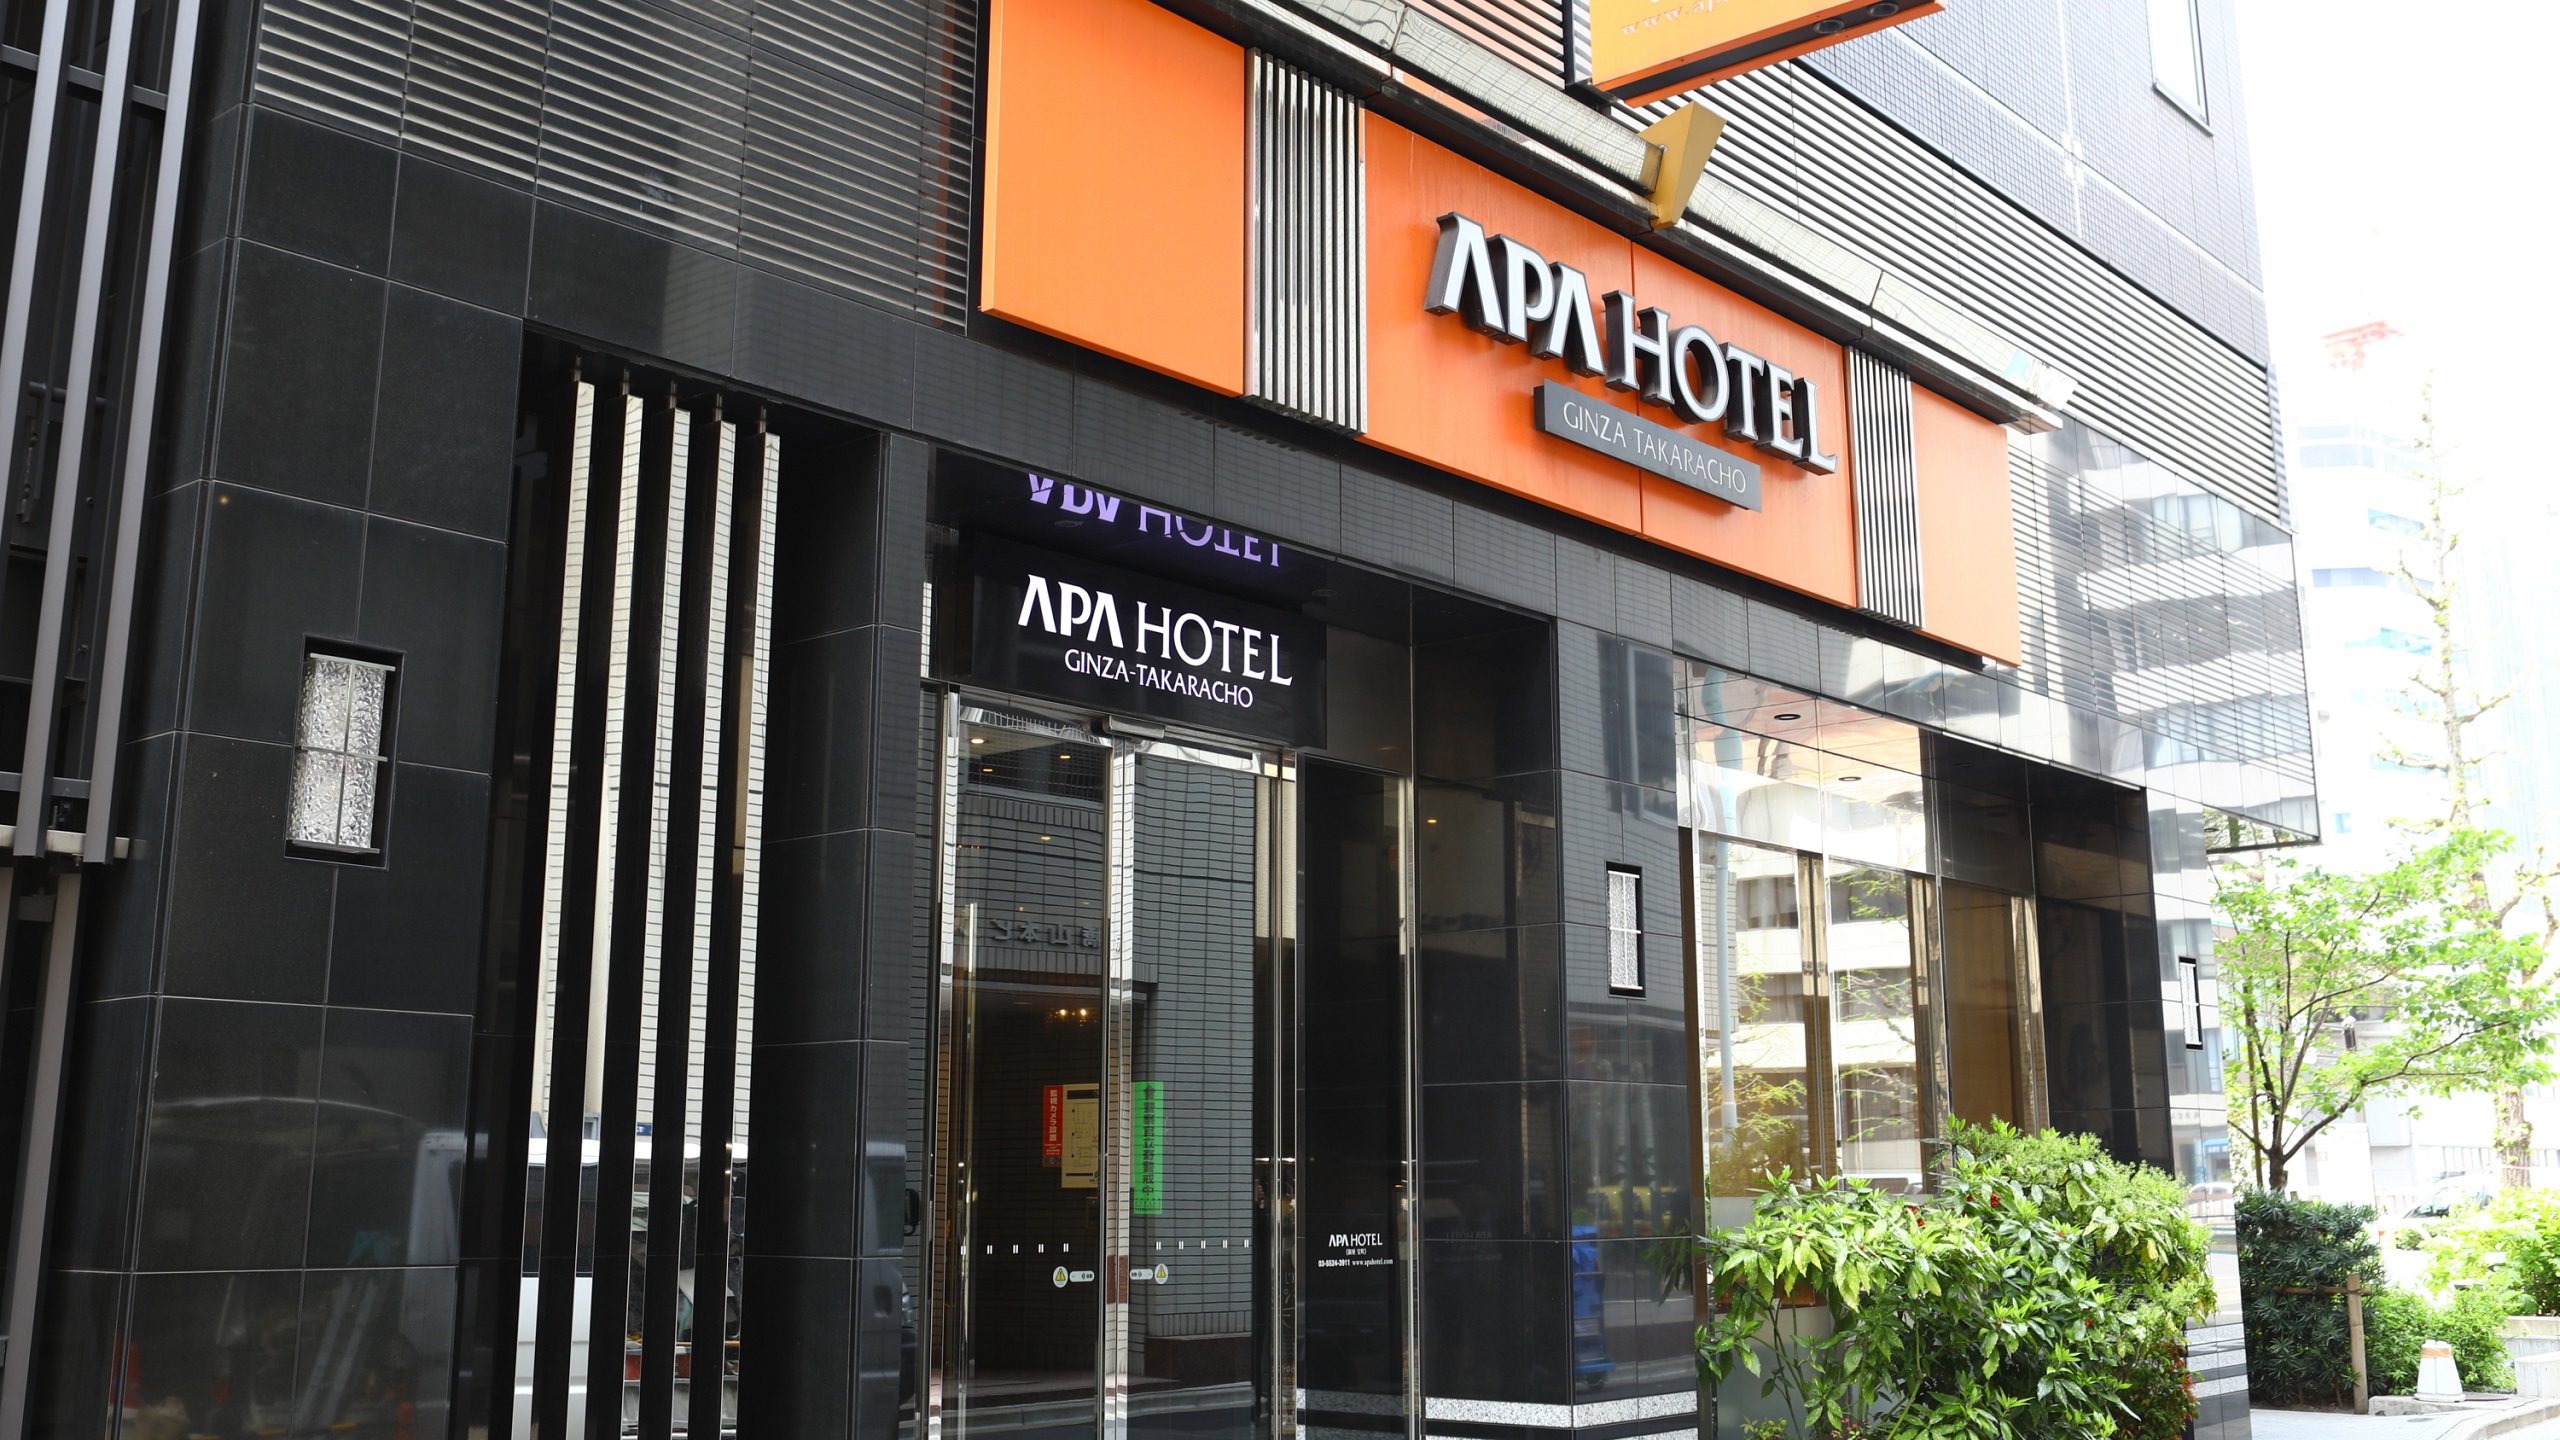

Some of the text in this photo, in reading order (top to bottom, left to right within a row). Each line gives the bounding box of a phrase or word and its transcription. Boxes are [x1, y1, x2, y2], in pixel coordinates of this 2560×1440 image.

[1425, 212, 1838, 476] APA HOTEL
[1017, 573, 1293, 687] APA HOTEL
[1064, 648, 1254, 708] GINZA-TAKARACHO
[1328, 1233, 1383, 1247] APA HOTEL
